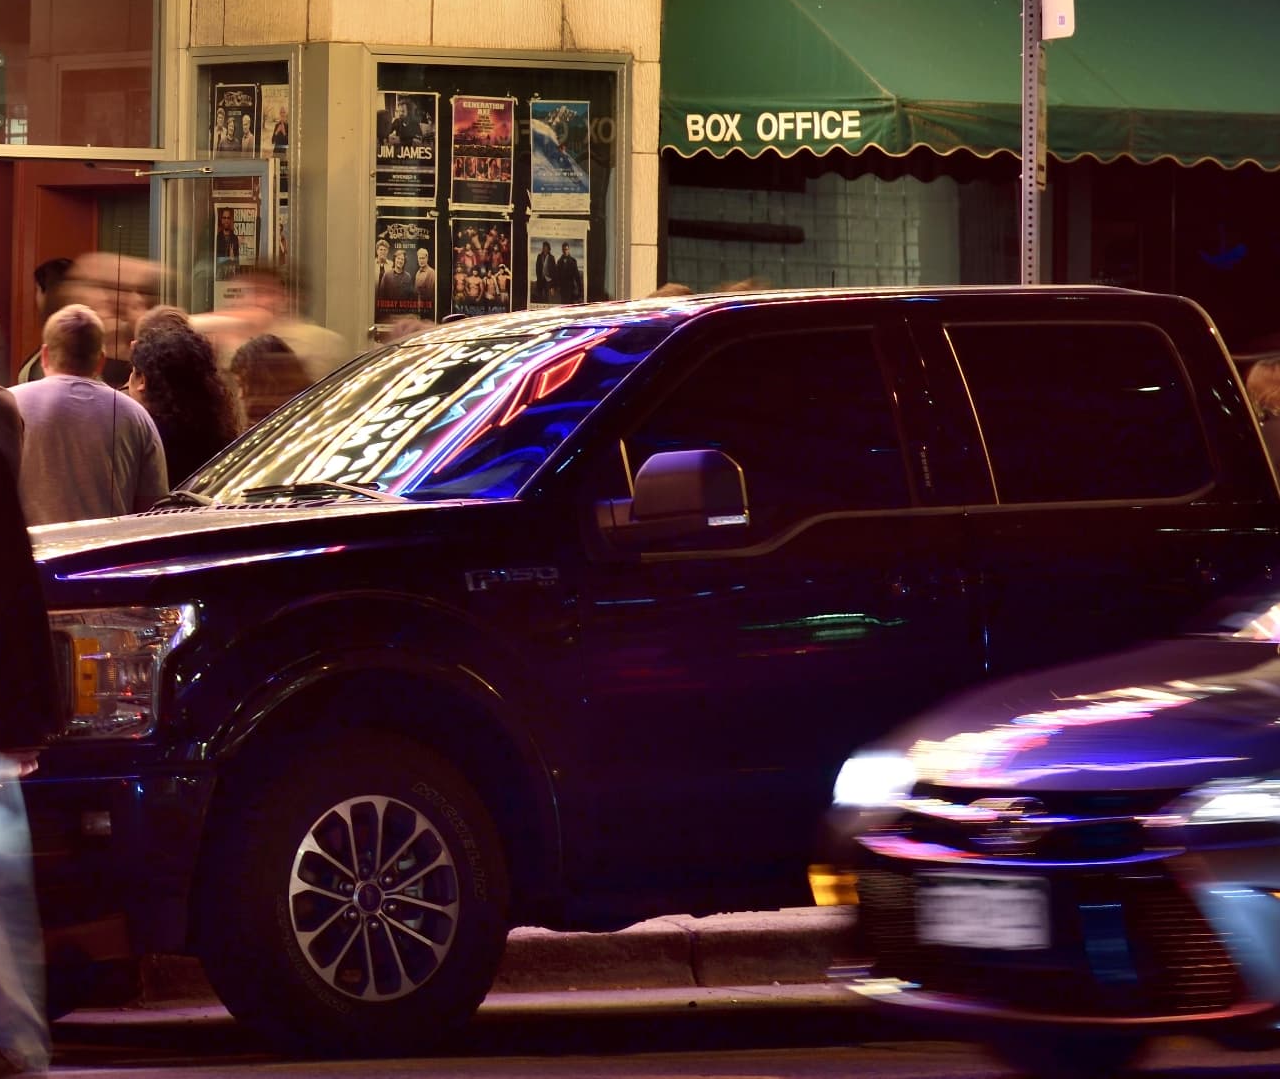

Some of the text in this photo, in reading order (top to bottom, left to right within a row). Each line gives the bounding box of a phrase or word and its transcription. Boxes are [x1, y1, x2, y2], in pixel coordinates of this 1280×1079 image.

[687, 110, 861, 142] BOX OFFICE
[377, 146, 432, 160] JIM JAMES
